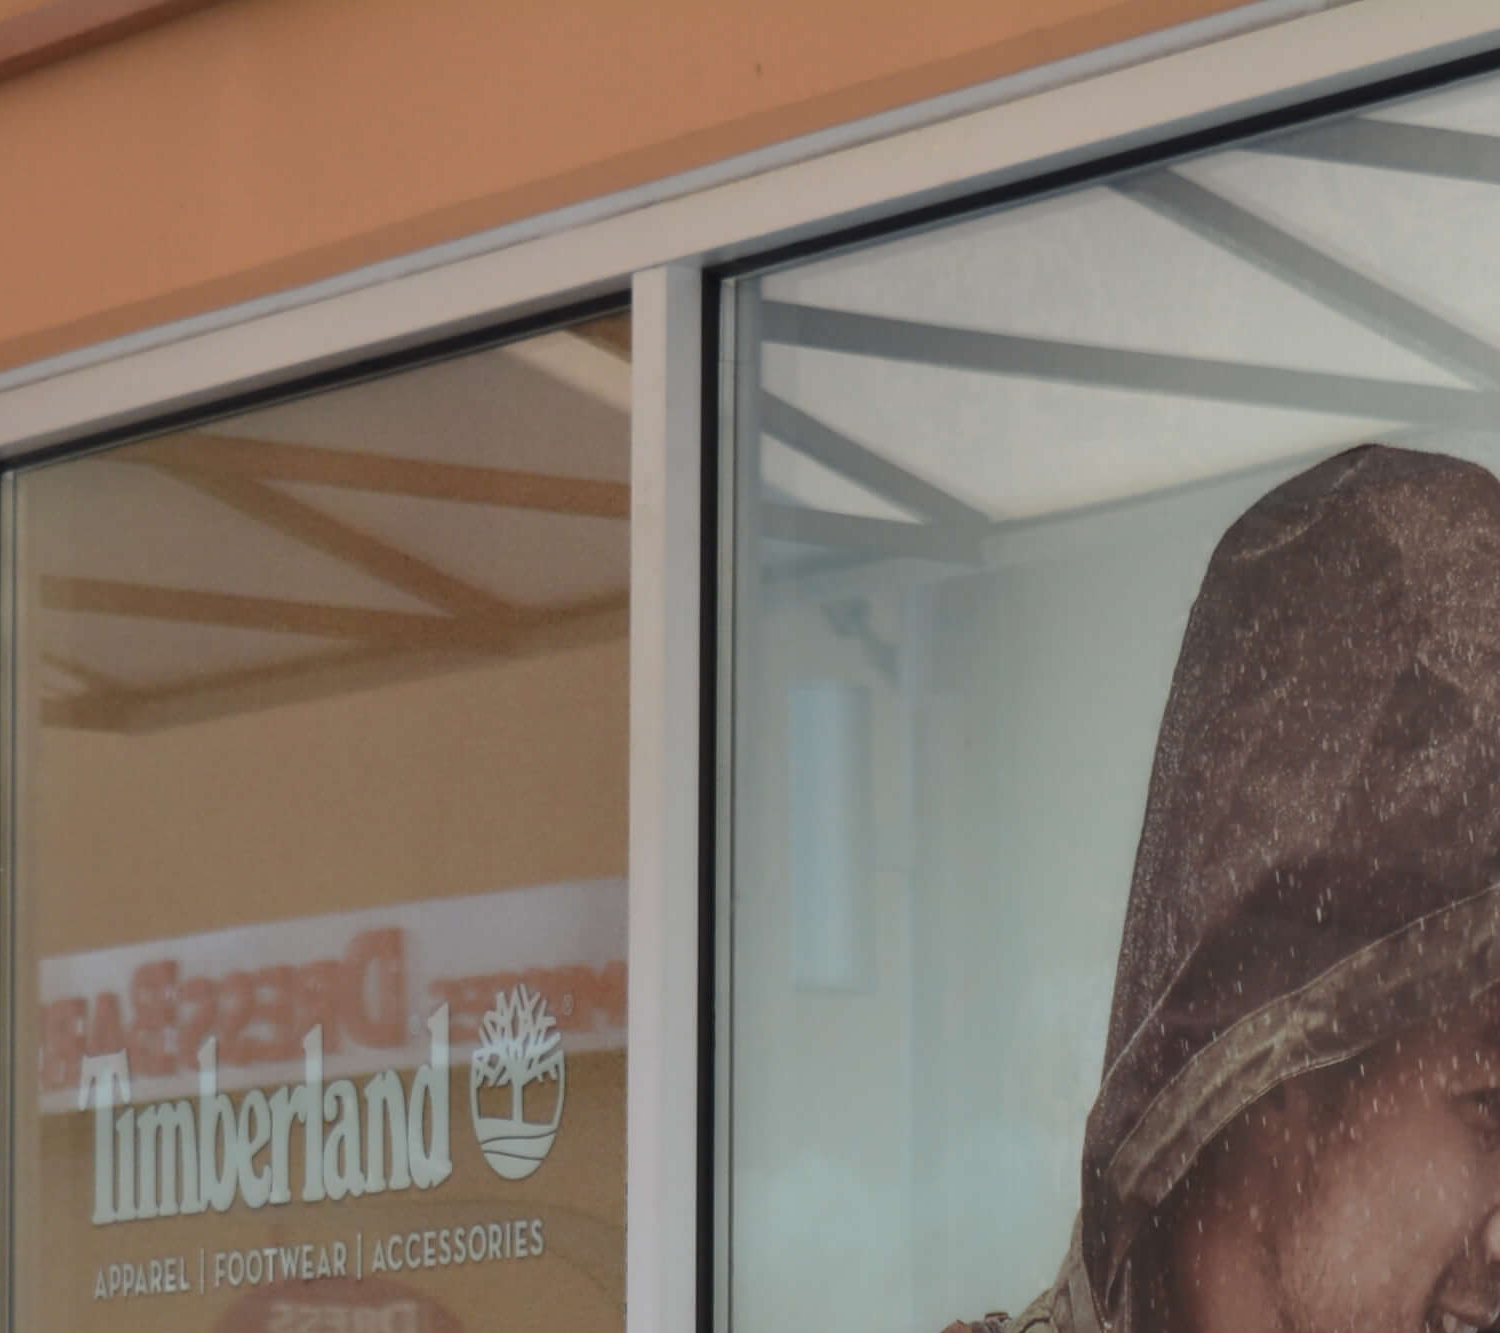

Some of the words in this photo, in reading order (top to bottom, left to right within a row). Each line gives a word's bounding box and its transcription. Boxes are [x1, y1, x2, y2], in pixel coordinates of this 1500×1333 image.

[78, 1002, 452, 1225] Timberland
[93, 1256, 190, 1300] APPAREL
[214, 1240, 348, 1288] FOOTWEAR
[372, 1218, 544, 1273] ACCESSORIES
